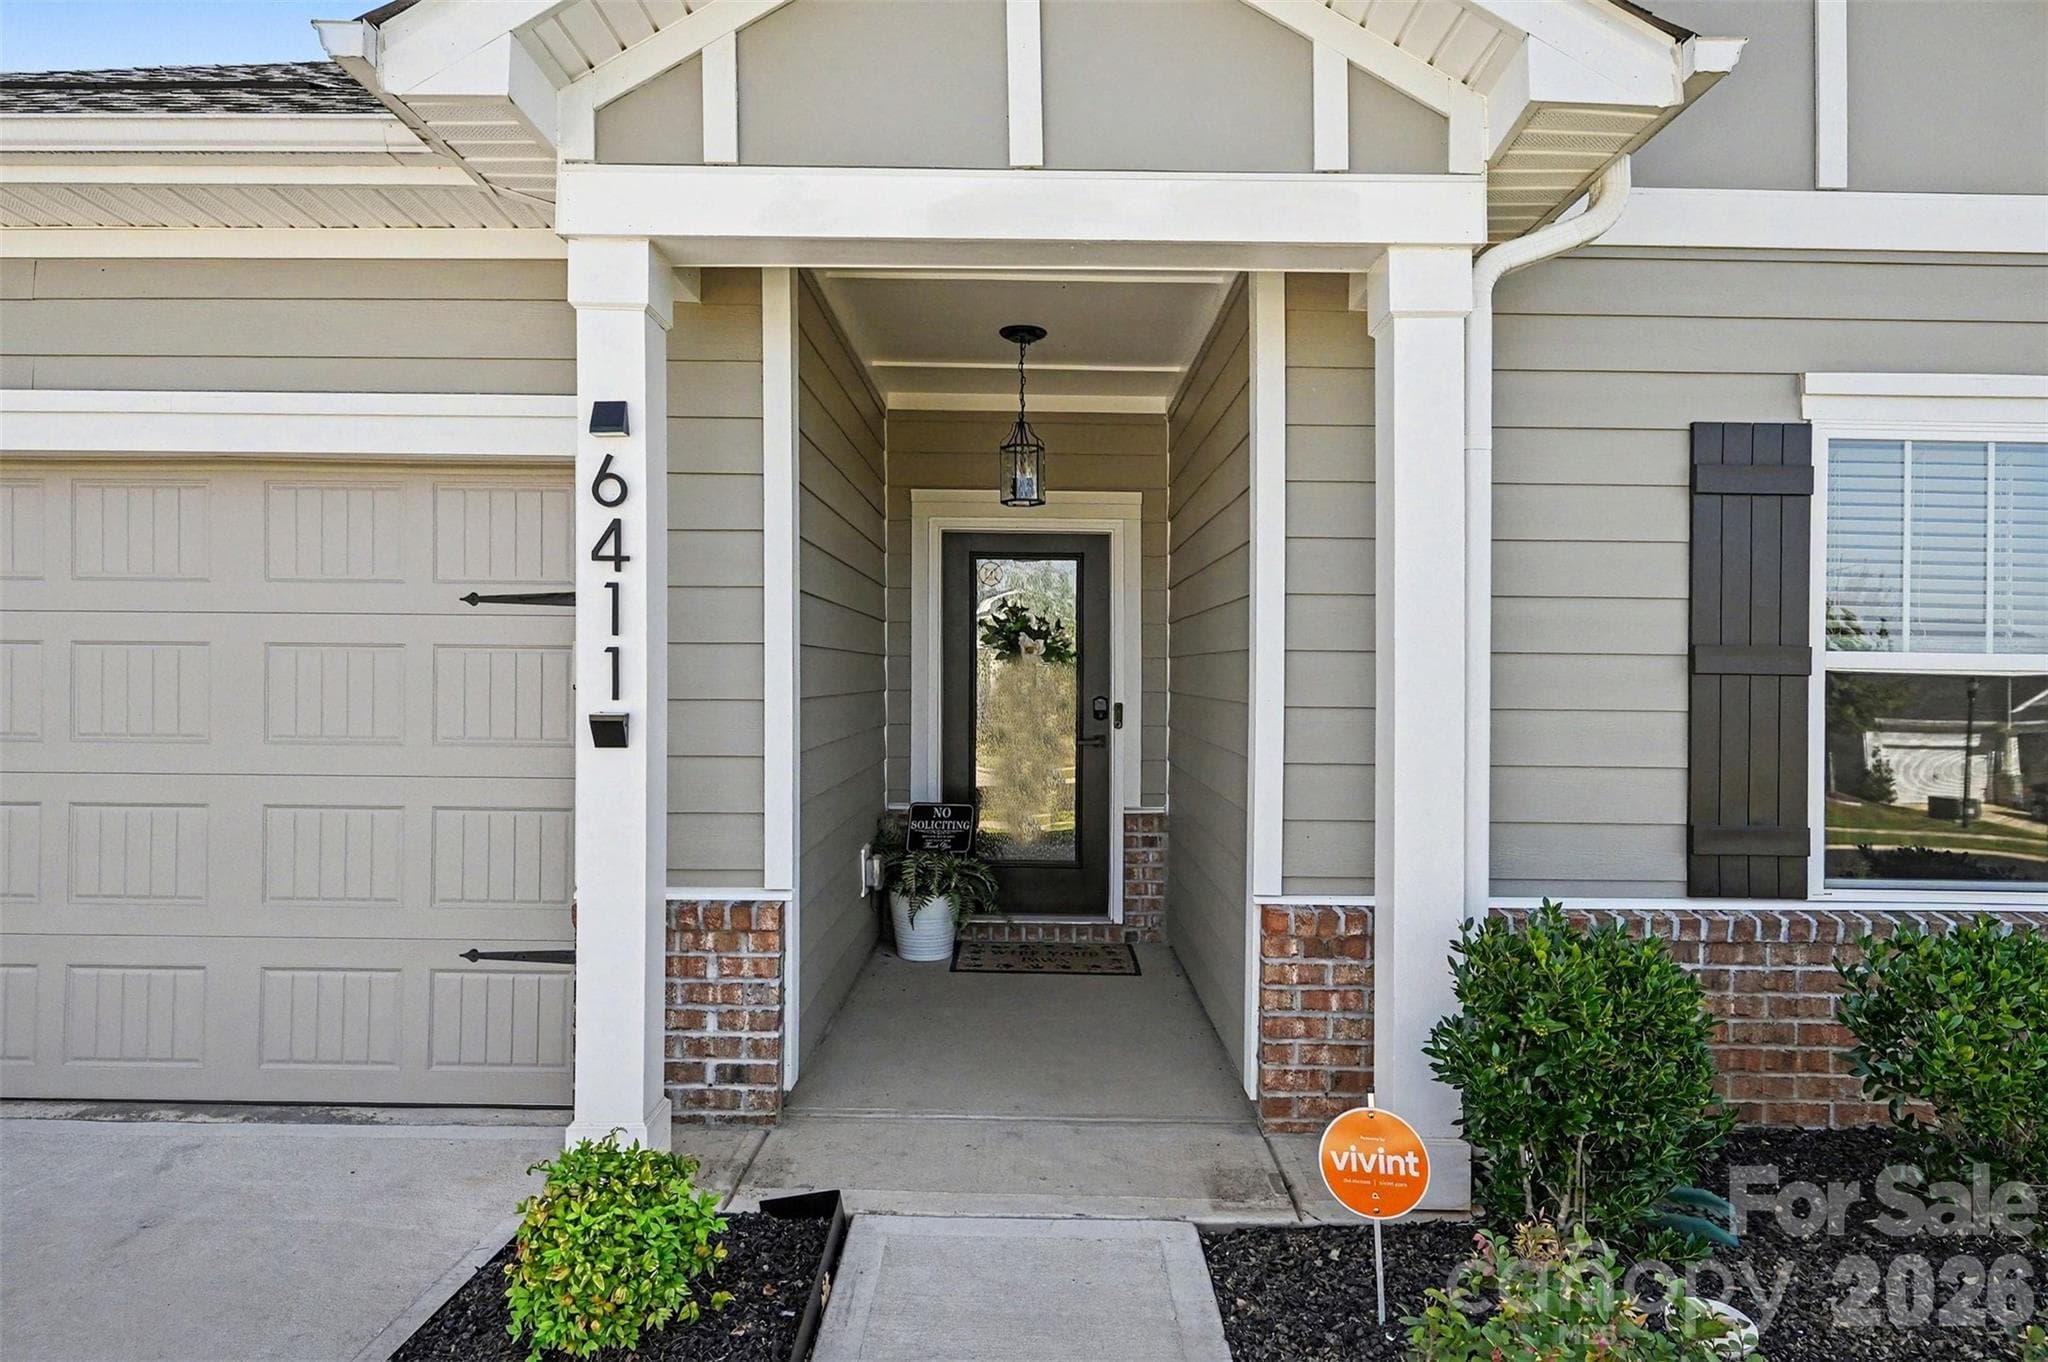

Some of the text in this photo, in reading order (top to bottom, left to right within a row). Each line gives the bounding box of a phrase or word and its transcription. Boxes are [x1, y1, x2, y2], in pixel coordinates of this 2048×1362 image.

[591, 453, 631, 701] 6411
[932, 806, 952, 818] NO
[910, 820, 970, 830] SOLICITING
[1329, 1144, 1420, 1177] vivint
